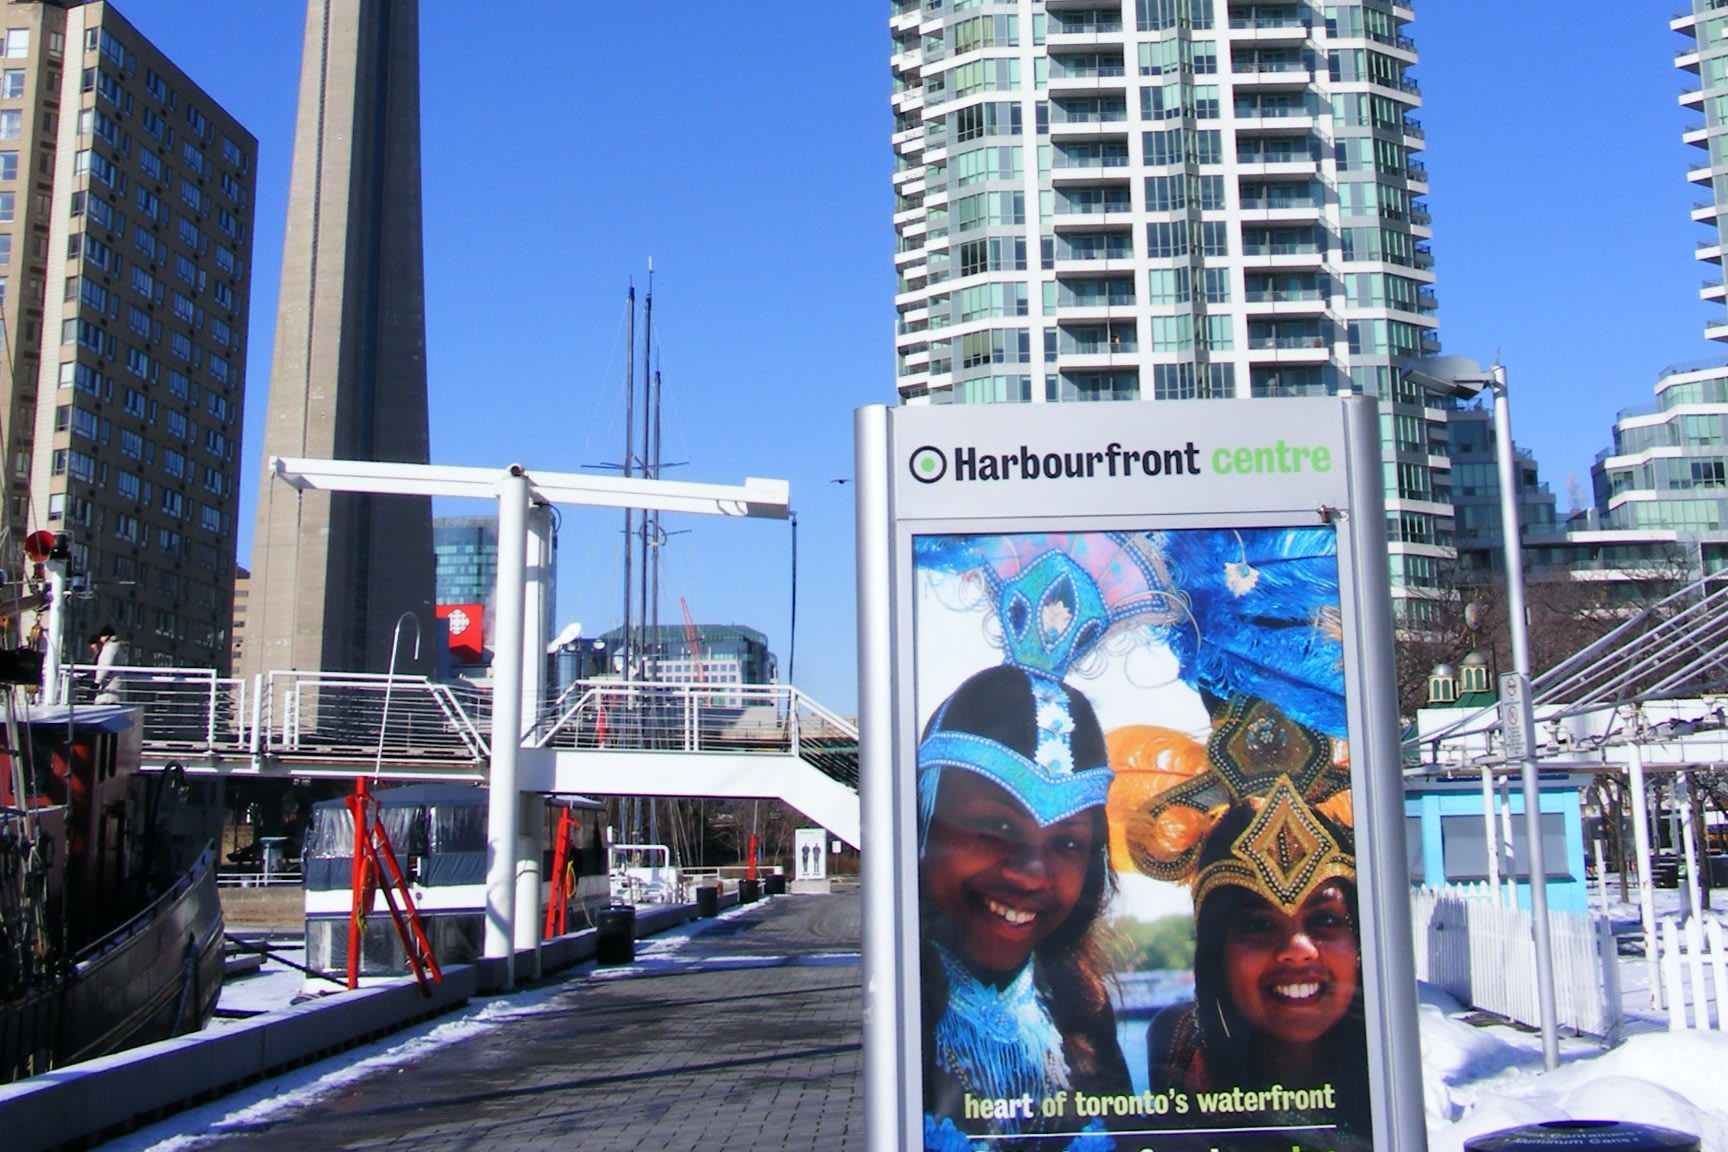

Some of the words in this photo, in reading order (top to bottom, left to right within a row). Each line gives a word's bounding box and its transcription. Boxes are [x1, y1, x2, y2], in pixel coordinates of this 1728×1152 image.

[954, 442, 1200, 481] Harbourfront
[1211, 440, 1331, 475] centre
[964, 1092, 1035, 1119] heart
[1041, 1090, 1068, 1117] of
[1074, 1087, 1189, 1116] toronto's
[1196, 1083, 1336, 1113] waterfront
